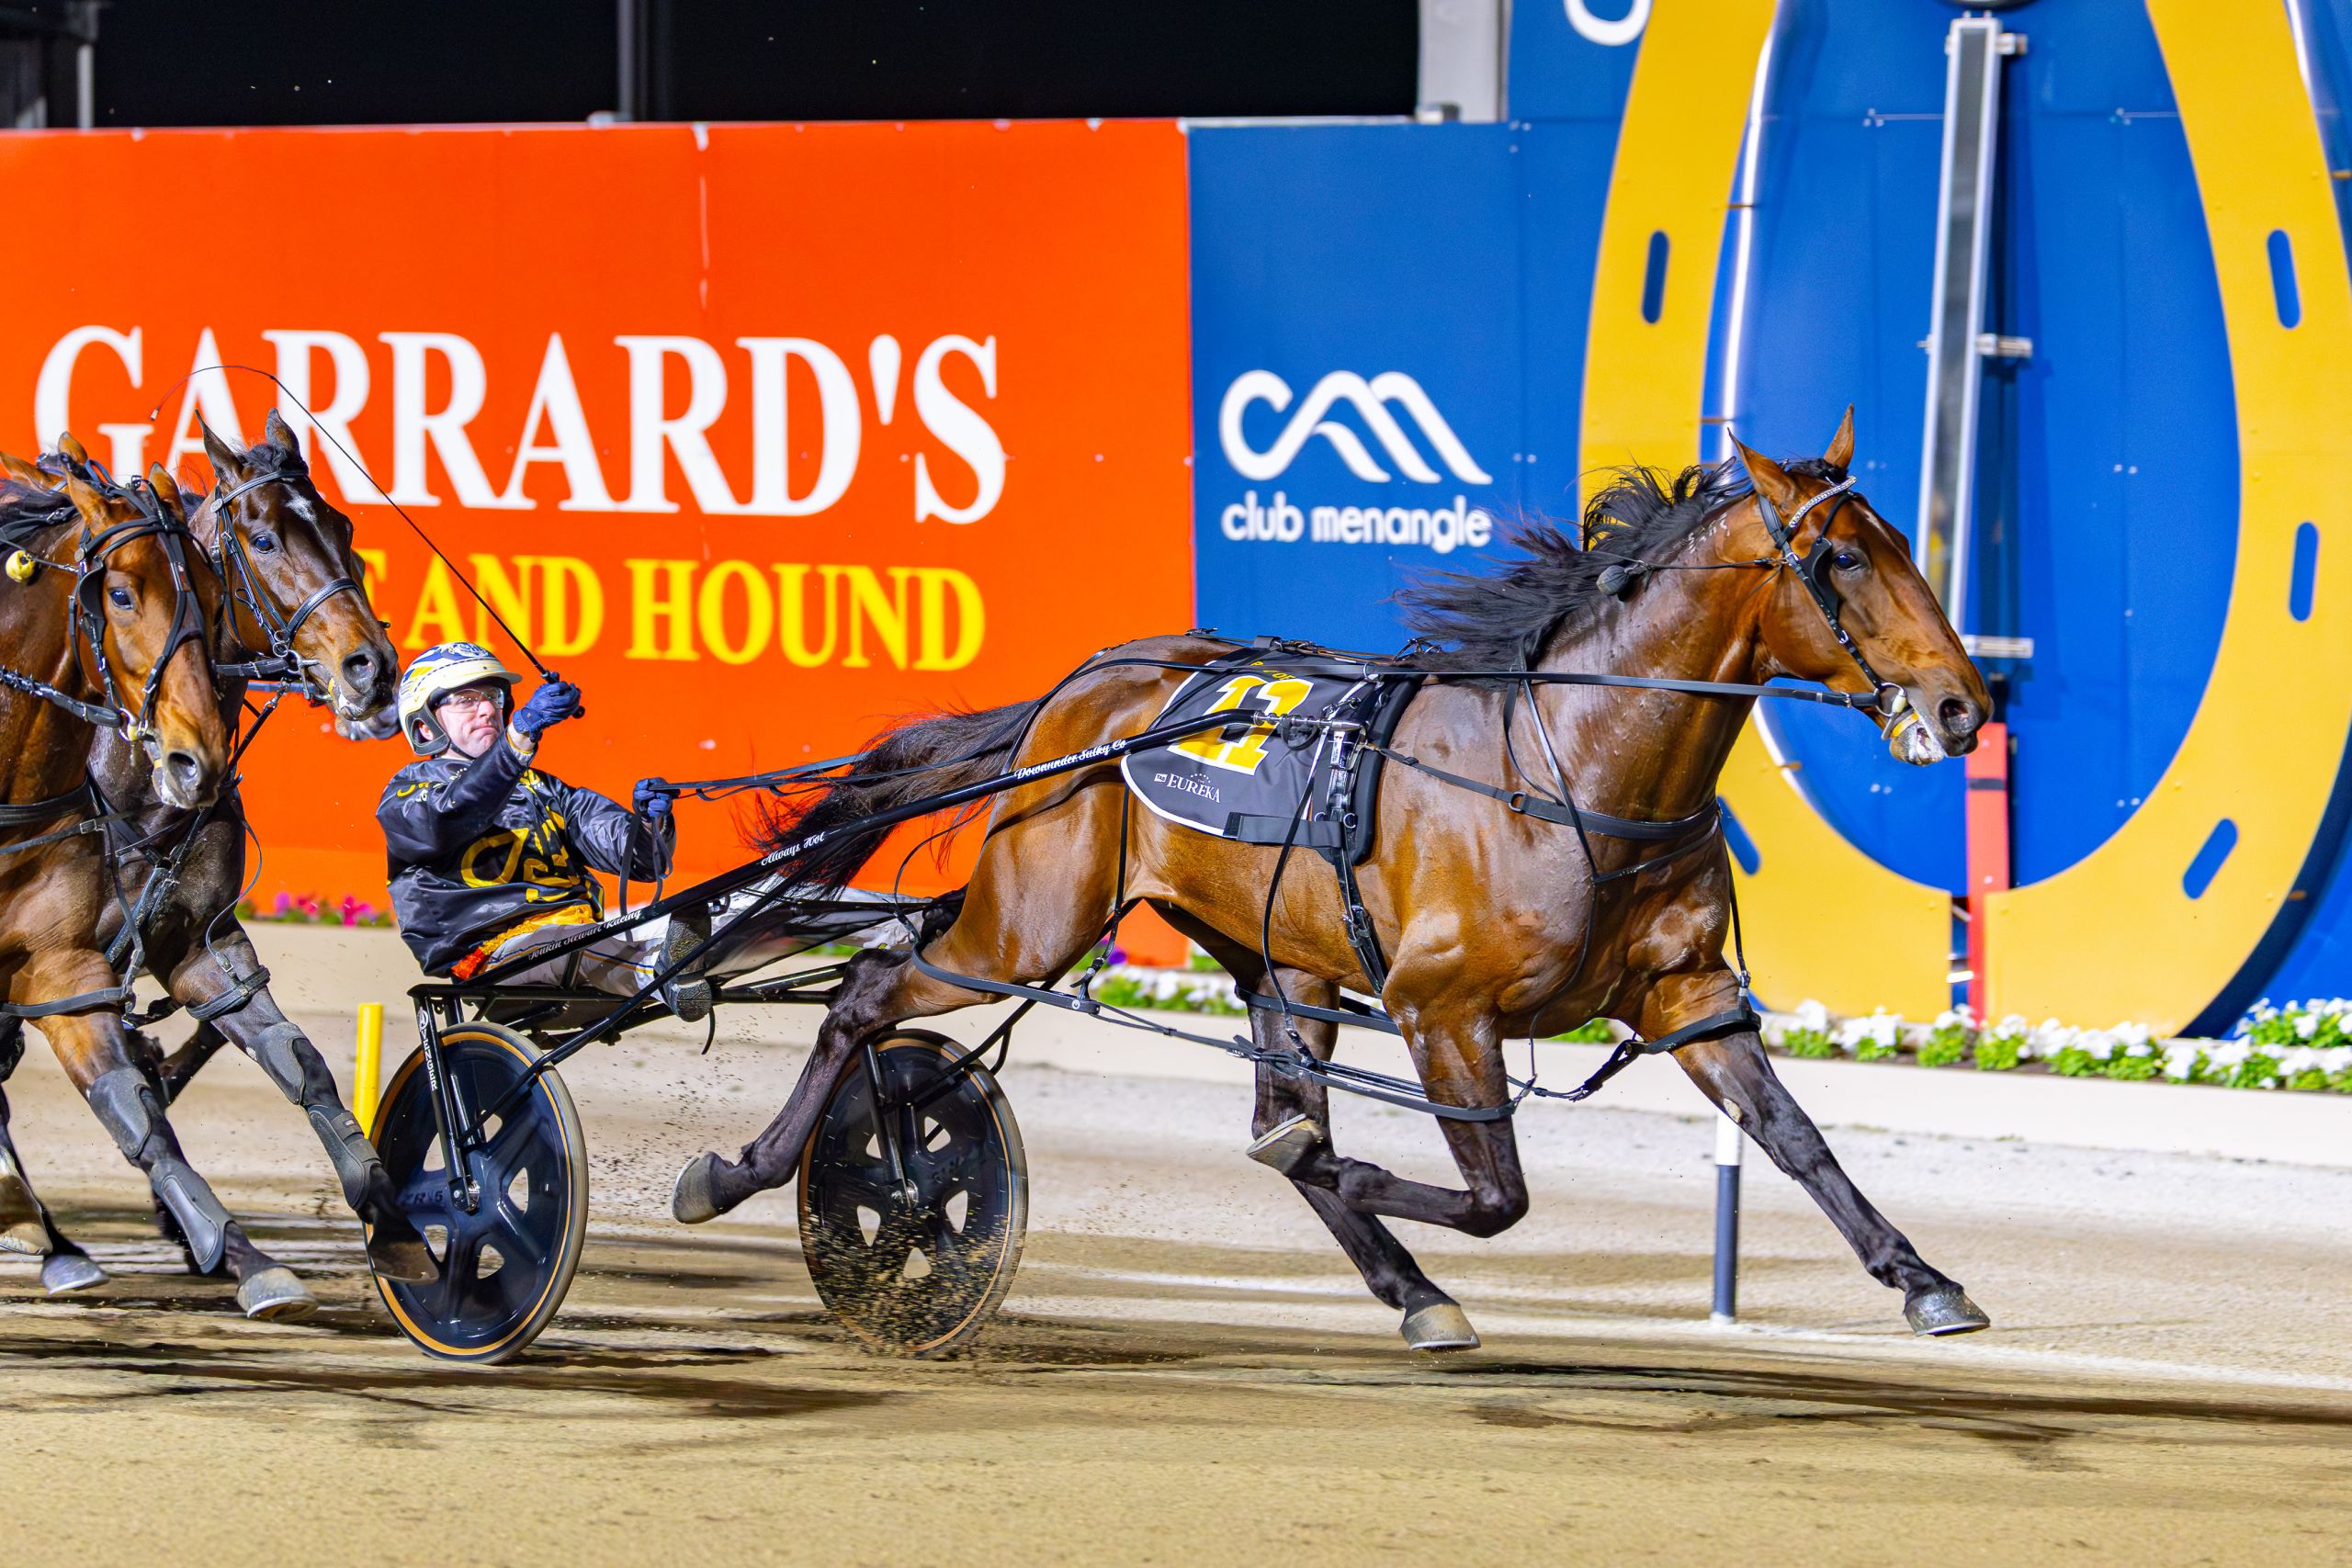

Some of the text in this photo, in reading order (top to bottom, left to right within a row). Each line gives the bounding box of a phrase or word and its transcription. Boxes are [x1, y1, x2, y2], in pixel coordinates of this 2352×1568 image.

[34, 325, 1006, 525] GARRARD'S
[1221, 491, 1493, 554] club menangle
[402, 552, 604, 657] AND
[624, 558, 985, 671] HOUND
[1167, 773, 1220, 803] EUREKA
[761, 831, 826, 865] Always Hot
[604, 909, 641, 929] Racing
[417, 1006, 438, 1092] AVENGER
